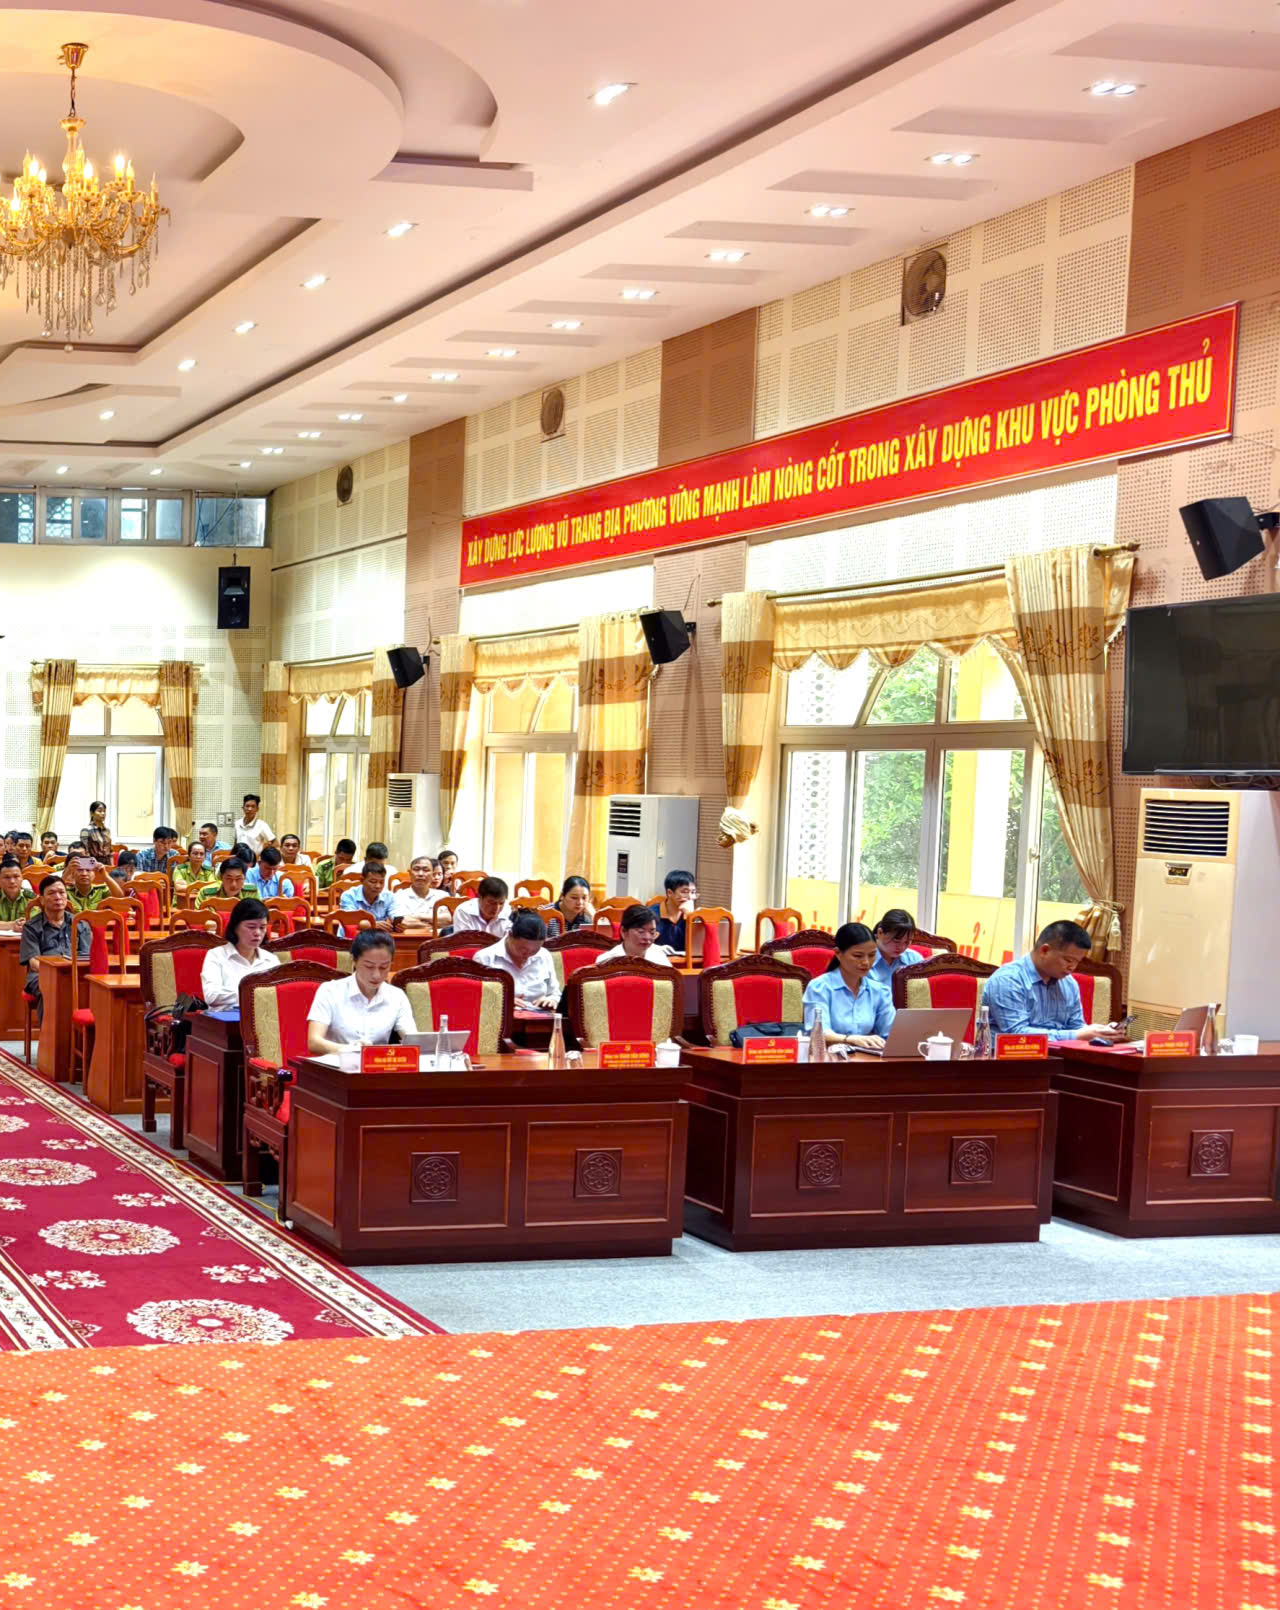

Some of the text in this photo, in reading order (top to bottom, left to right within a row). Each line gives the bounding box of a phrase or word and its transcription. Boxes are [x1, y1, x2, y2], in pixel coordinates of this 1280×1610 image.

[467, 337, 1213, 568] XÂY DỰNG LỰC LƯỢNG VŨ TRANG ĐỊA PHƯƠNG VỮNG MẠNH LÀM NÒNG CỐT TRONG XÂY DỰNG KHU VỰC PHÒNG THỦ
